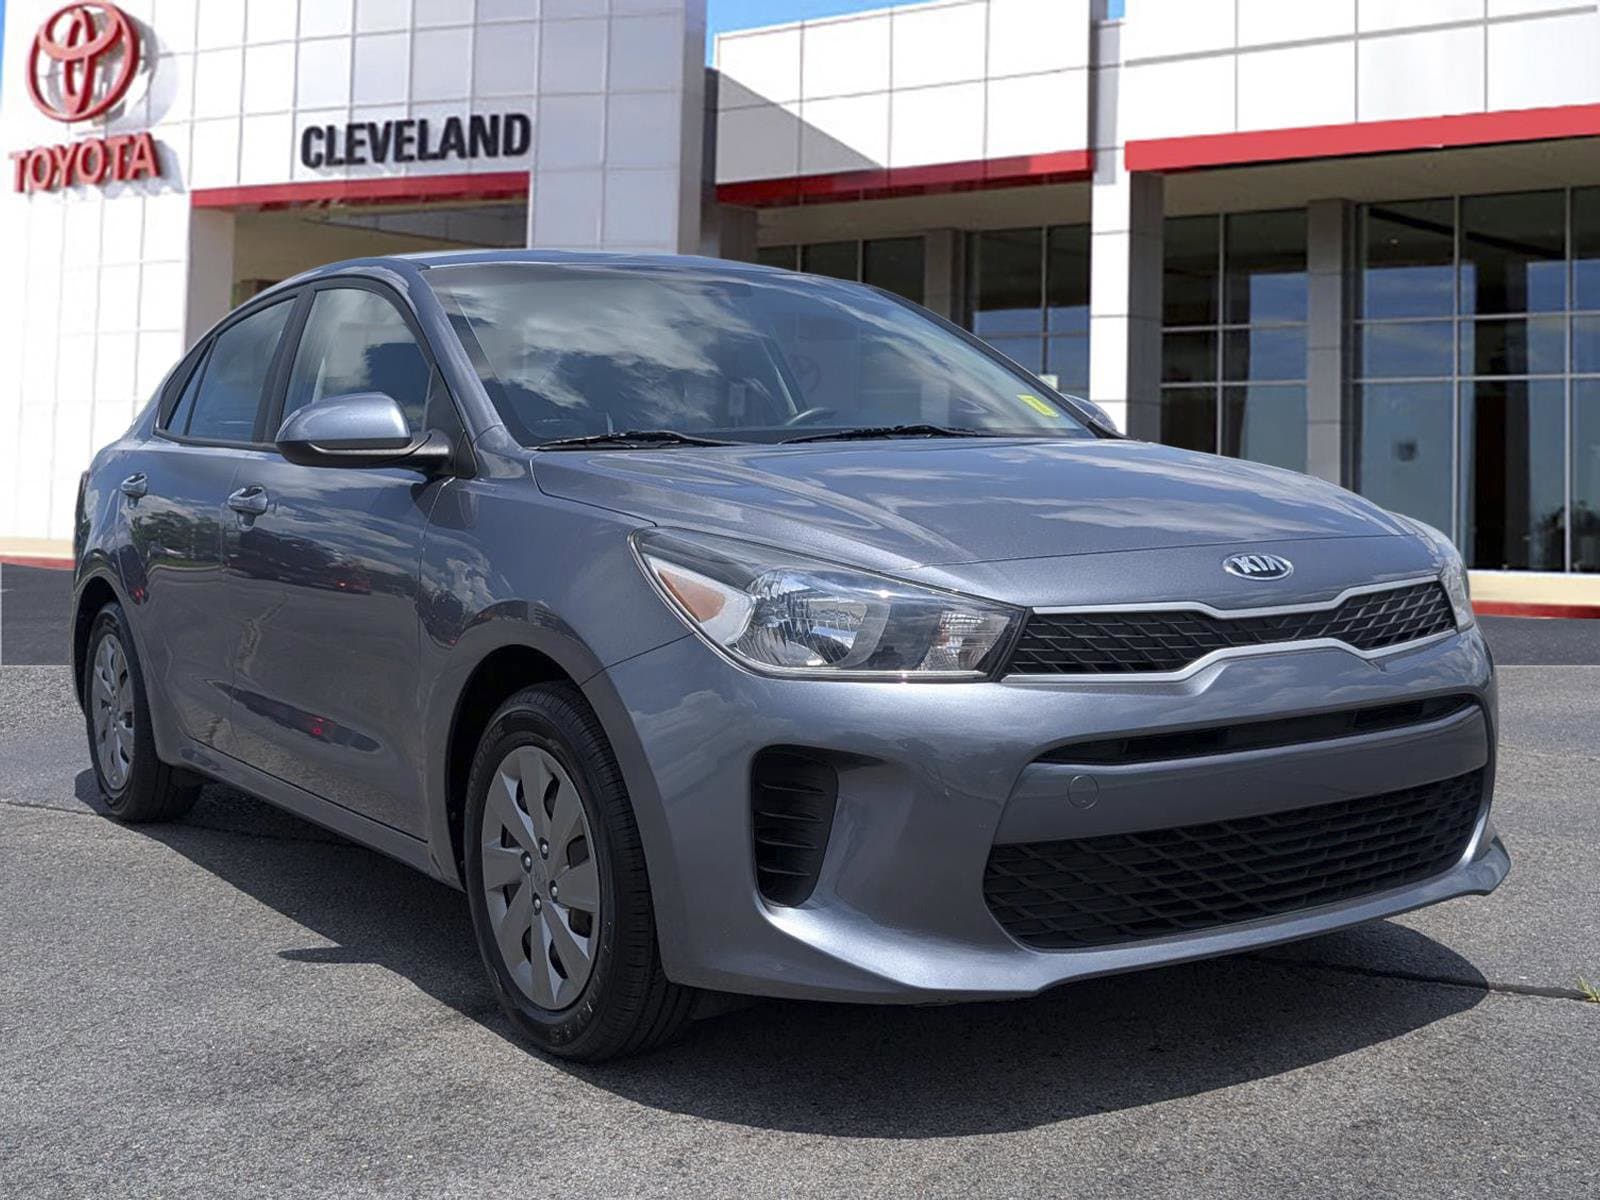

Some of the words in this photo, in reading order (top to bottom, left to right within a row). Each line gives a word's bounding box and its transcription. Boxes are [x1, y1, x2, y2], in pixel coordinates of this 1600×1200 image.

[9, 131, 160, 193] TOYOTA
[301, 113, 531, 168] CLEVELAND
[1231, 555, 1285, 573] KIA
